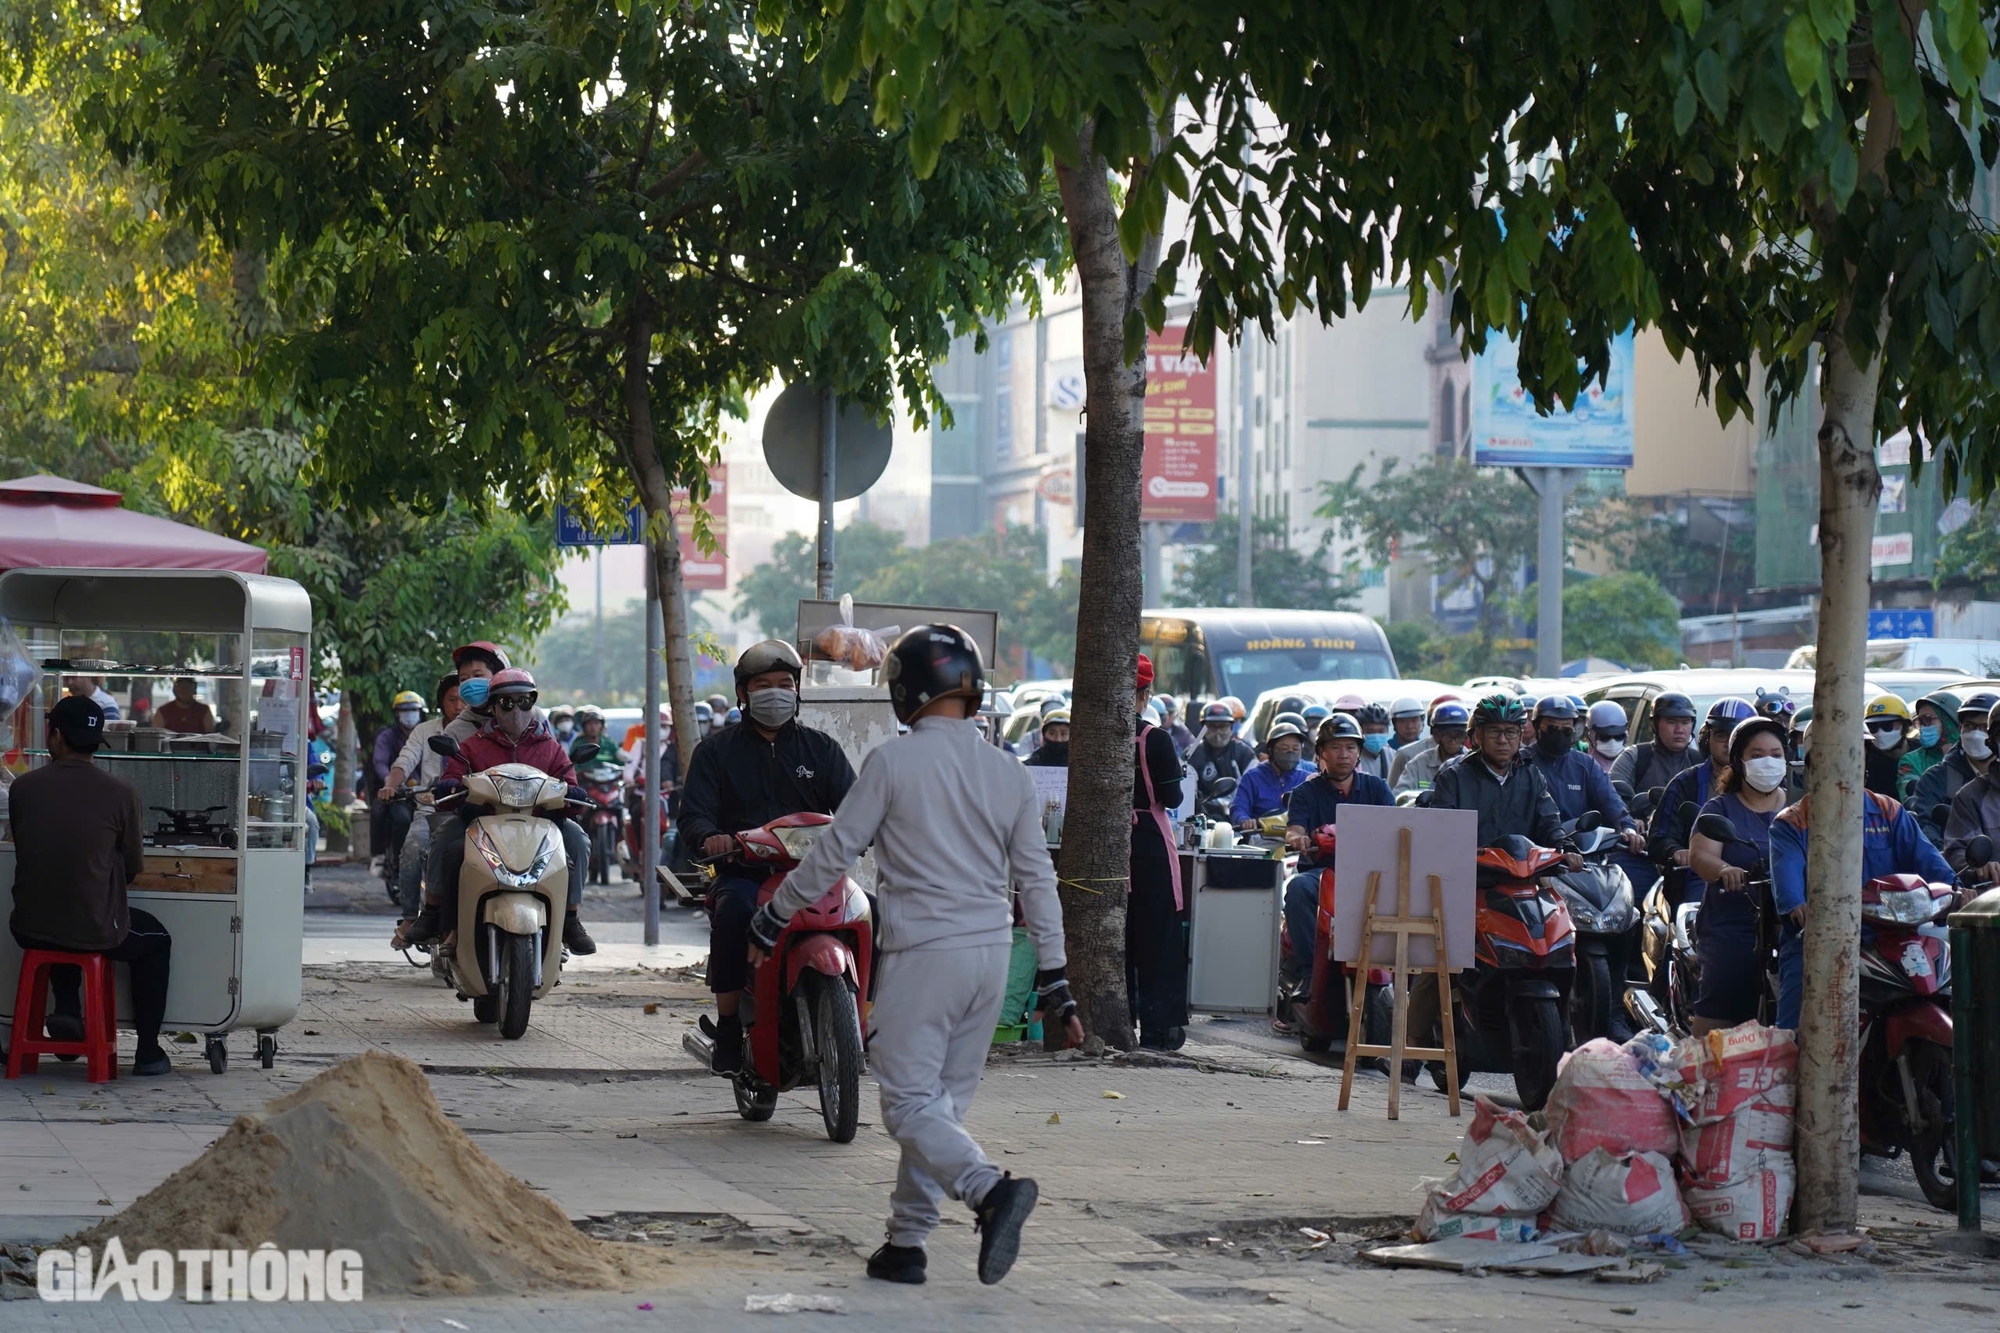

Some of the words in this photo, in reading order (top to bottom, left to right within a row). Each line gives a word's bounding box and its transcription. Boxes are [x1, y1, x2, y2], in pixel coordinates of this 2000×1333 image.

[1448, 1182, 1482, 1214] LONG
[1714, 1203, 1730, 1213] 40
[1765, 1196, 1775, 1234] LONG
[1742, 1225, 1754, 1236] 40
